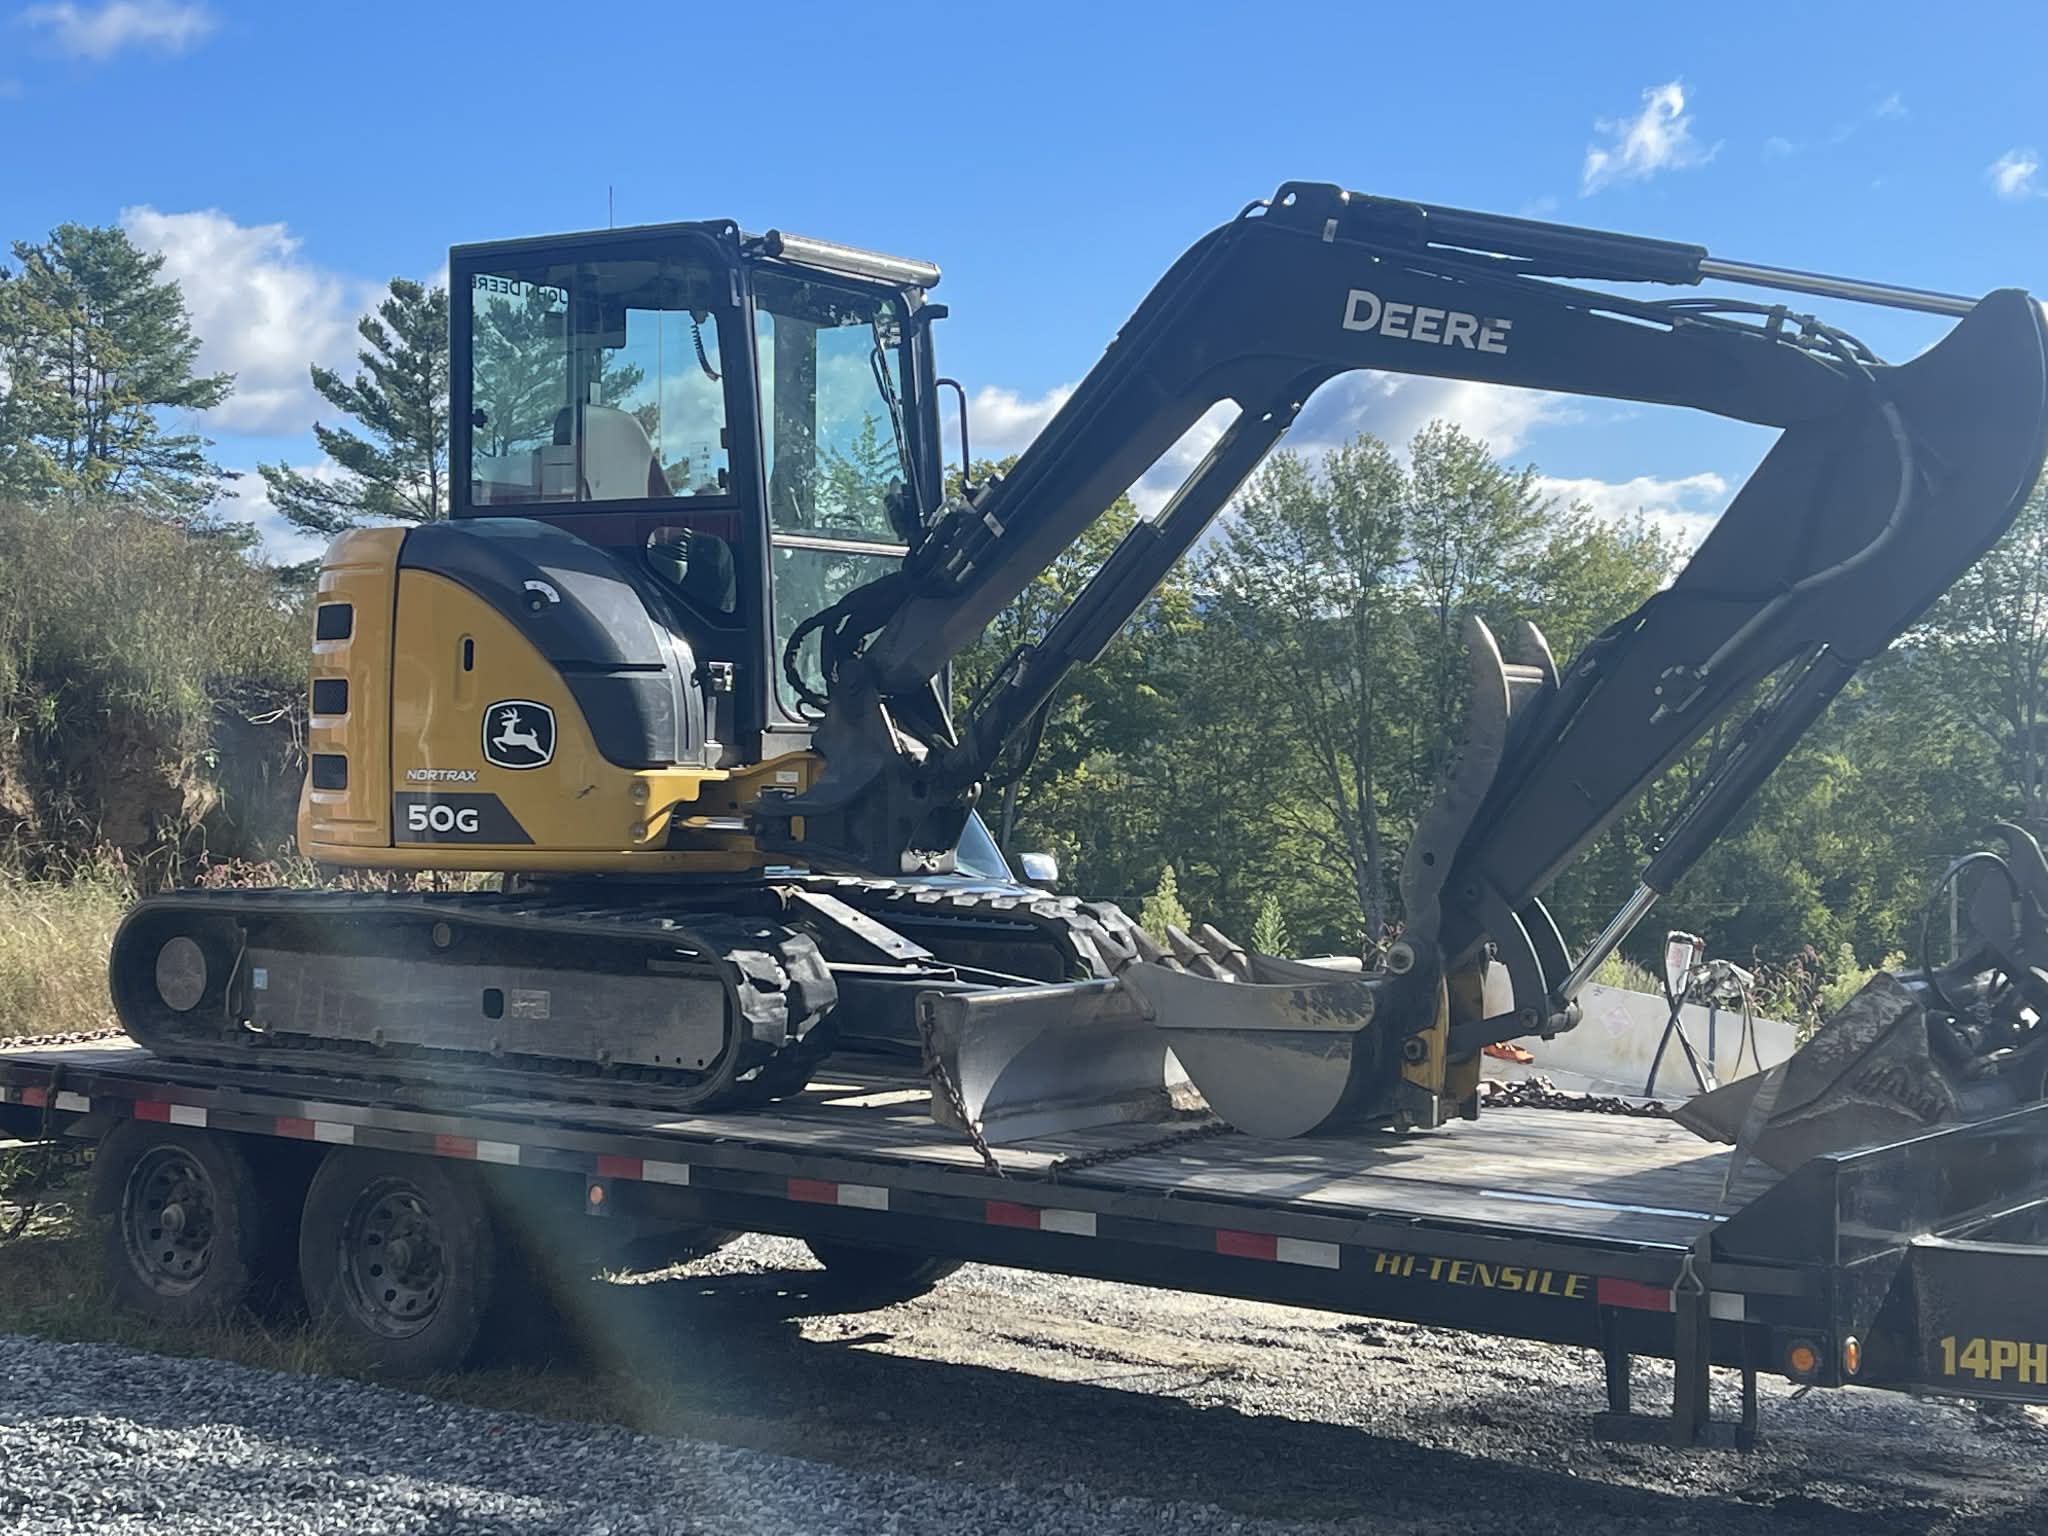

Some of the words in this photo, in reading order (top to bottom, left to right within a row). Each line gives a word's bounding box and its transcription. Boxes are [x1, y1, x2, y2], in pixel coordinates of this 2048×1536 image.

[1342, 289, 1512, 354] DEERE
[406, 769, 478, 782] NORTRAX
[408, 804, 479, 832] 50G
[1374, 1253, 1592, 1299] HI-TENSILE
[1940, 1335, 2048, 1384] 14PH
